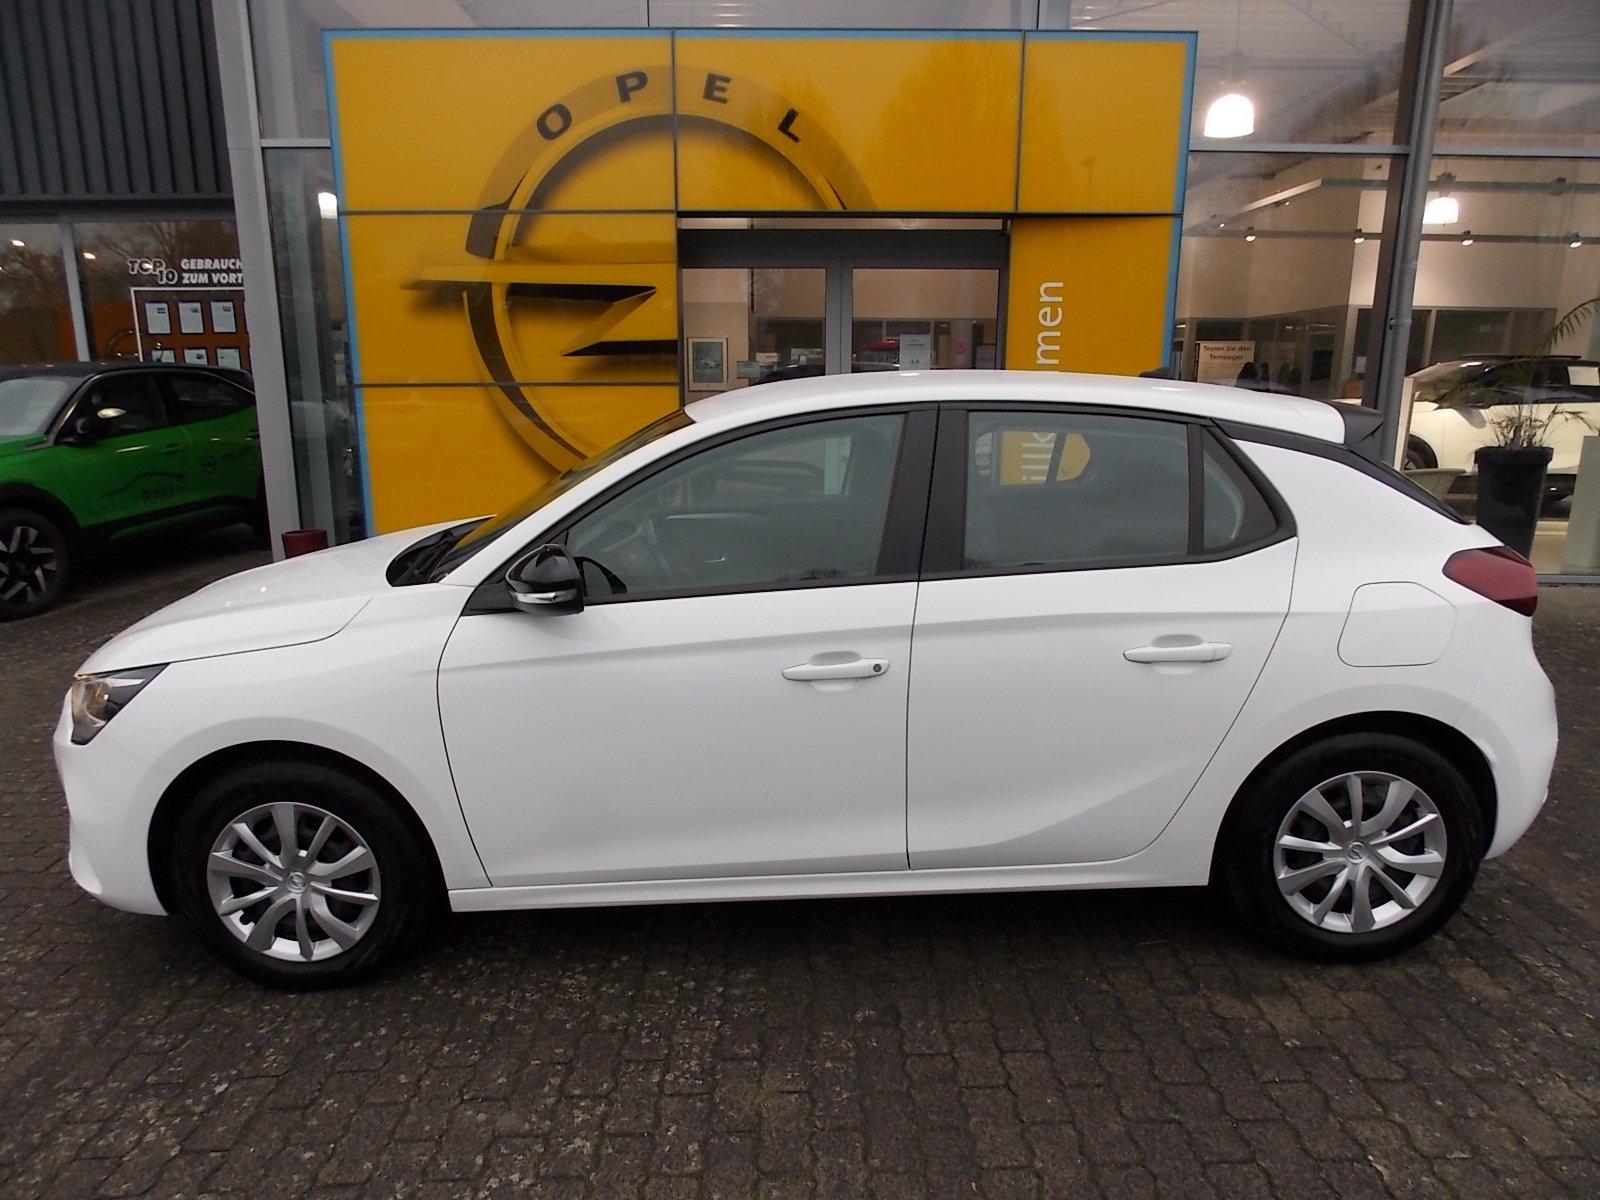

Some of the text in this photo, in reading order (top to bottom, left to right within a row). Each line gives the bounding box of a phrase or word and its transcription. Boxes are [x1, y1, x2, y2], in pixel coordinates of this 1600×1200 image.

[536, 70, 801, 143] OPEL
[127, 258, 179, 285] TOP 10
[182, 272, 209, 284] ZUM
[1036, 281, 1064, 365] men
